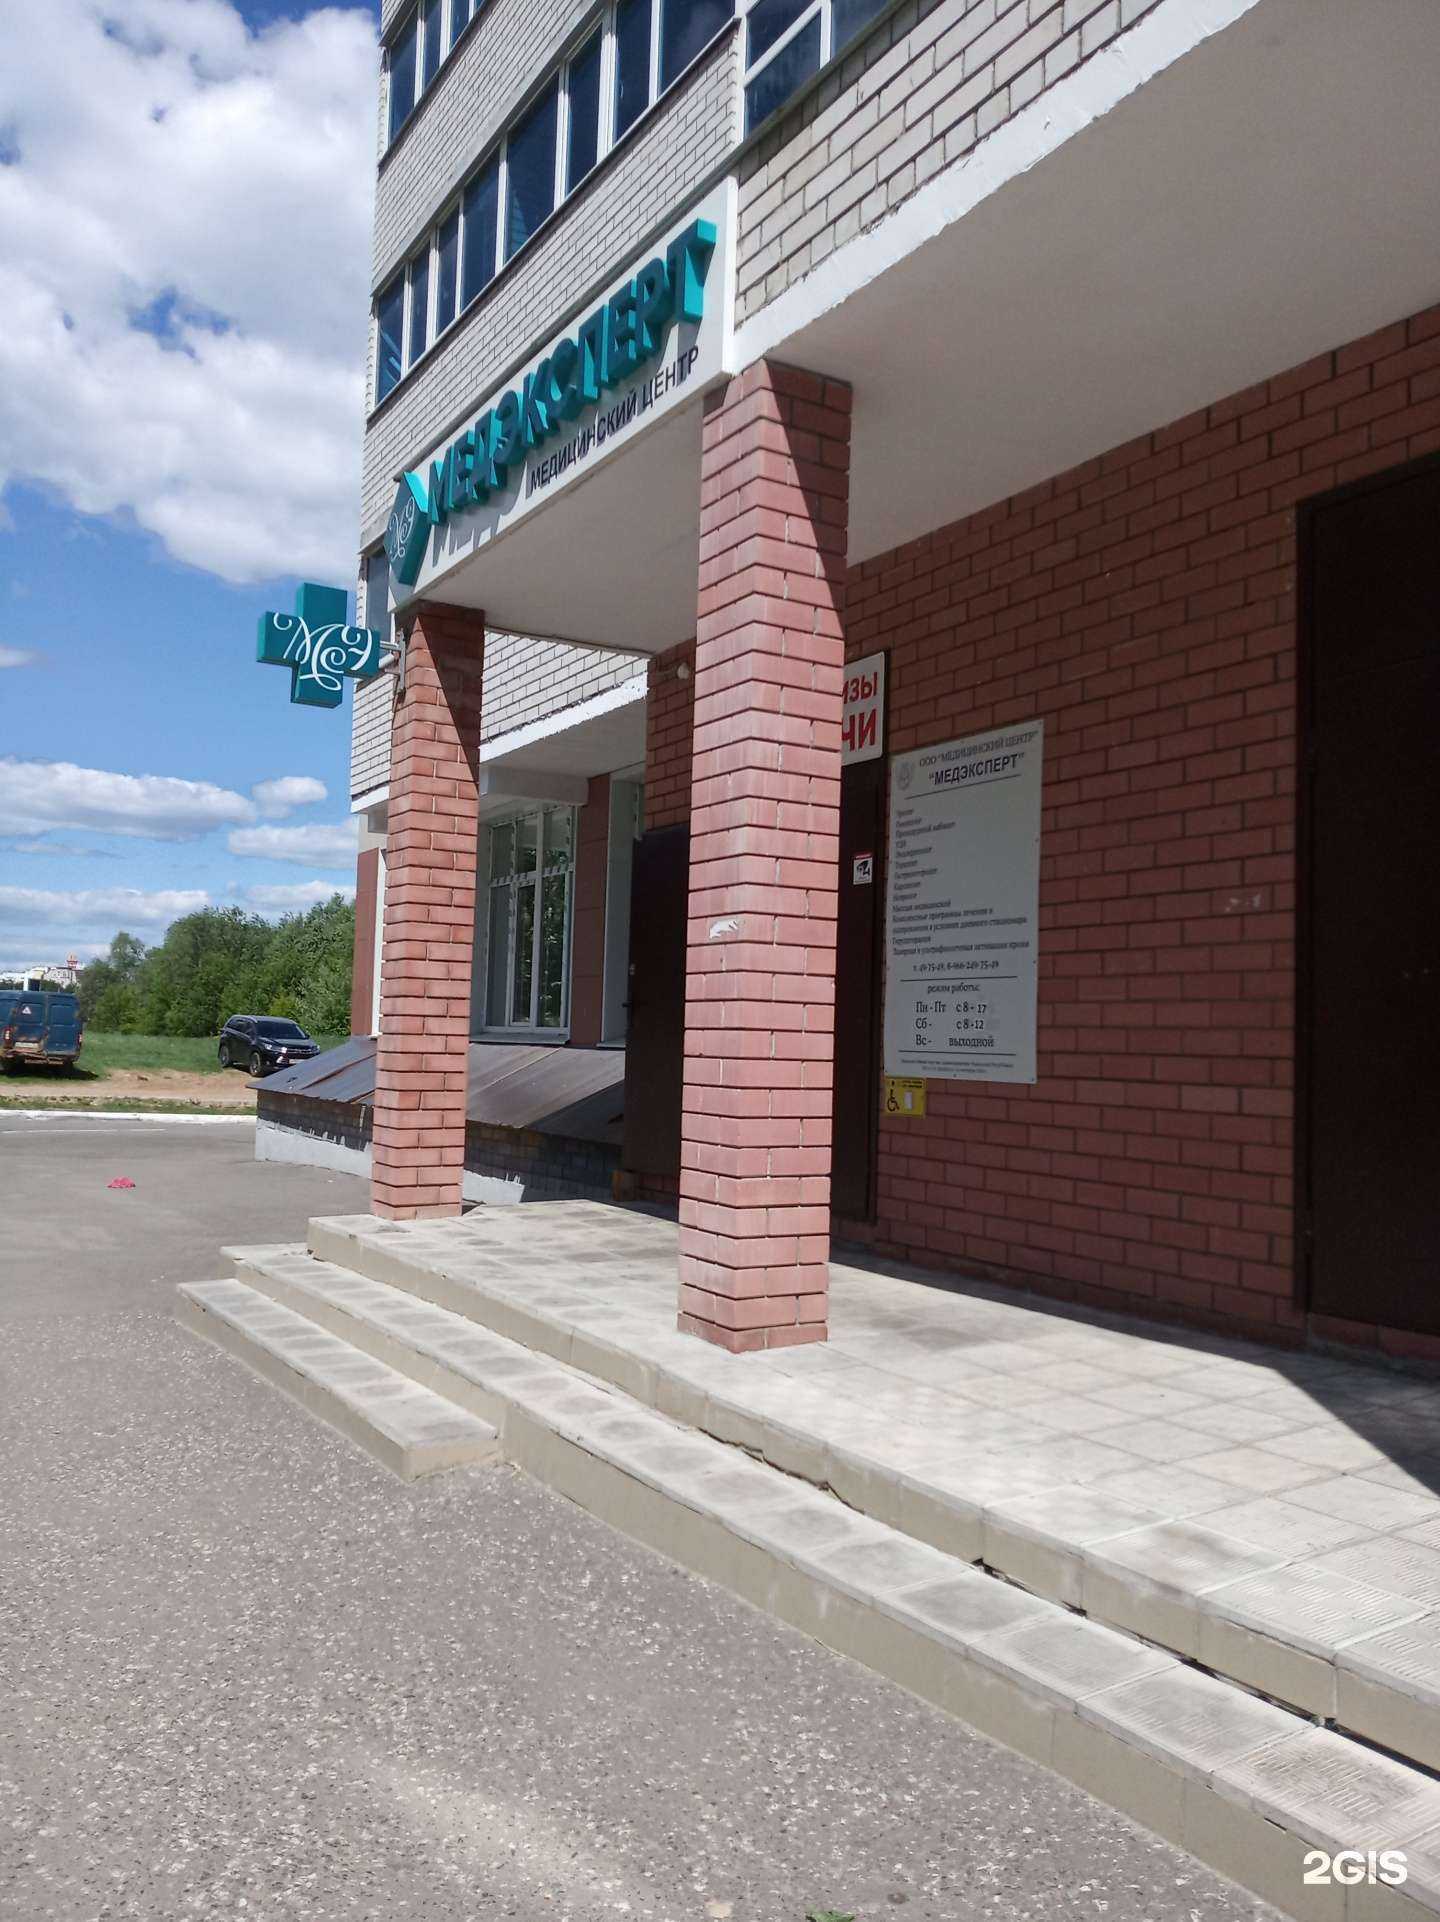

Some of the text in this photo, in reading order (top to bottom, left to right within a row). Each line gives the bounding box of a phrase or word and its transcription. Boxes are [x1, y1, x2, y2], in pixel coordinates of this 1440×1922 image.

[427, 217, 717, 525] МЕДЭКСПЕРТ
[530, 344, 699, 491] МЕДИЦИНСКИЙ ЦЕНТР
[919, 756, 937, 767] ООО
[929, 752, 1025, 785] "МЕДЭКСПЕРТ"
[948, 1035, 994, 1047] выходной
